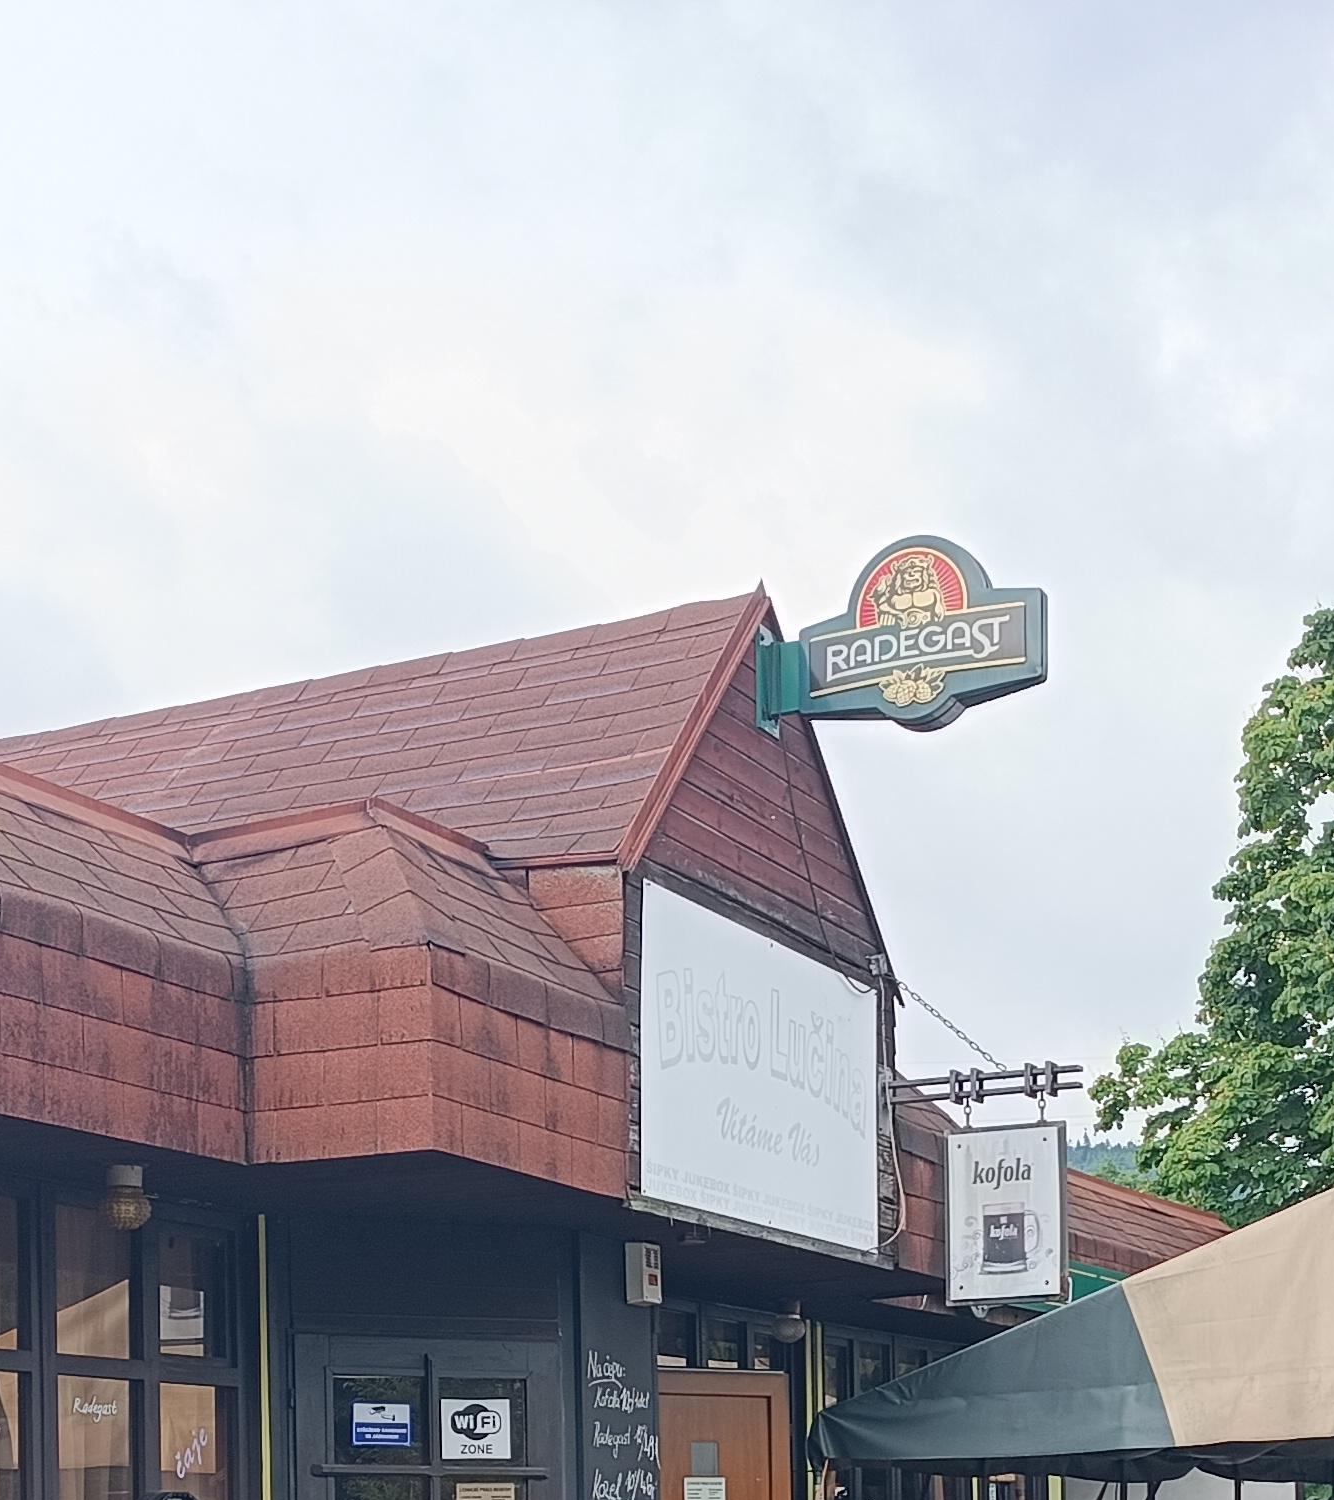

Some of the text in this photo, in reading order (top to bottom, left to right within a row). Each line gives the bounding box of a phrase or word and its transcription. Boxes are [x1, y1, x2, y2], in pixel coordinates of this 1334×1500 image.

[826, 614, 1010, 683] RADEGAST
[656, 967, 868, 1141] Bistro Lučina
[787, 1121, 820, 1168] Vás
[681, 1170, 731, 1195] JUKEBOX
[972, 1157, 1032, 1191] kofola
[989, 1221, 1018, 1242] kofola
[73, 1395, 118, 1423] Radegast
[175, 1427, 208, 1479] čaje
[460, 1444, 493, 1455] ZONE
[593, 1421, 631, 1459] Radegast
[592, 1468, 622, 1500] Kozel
